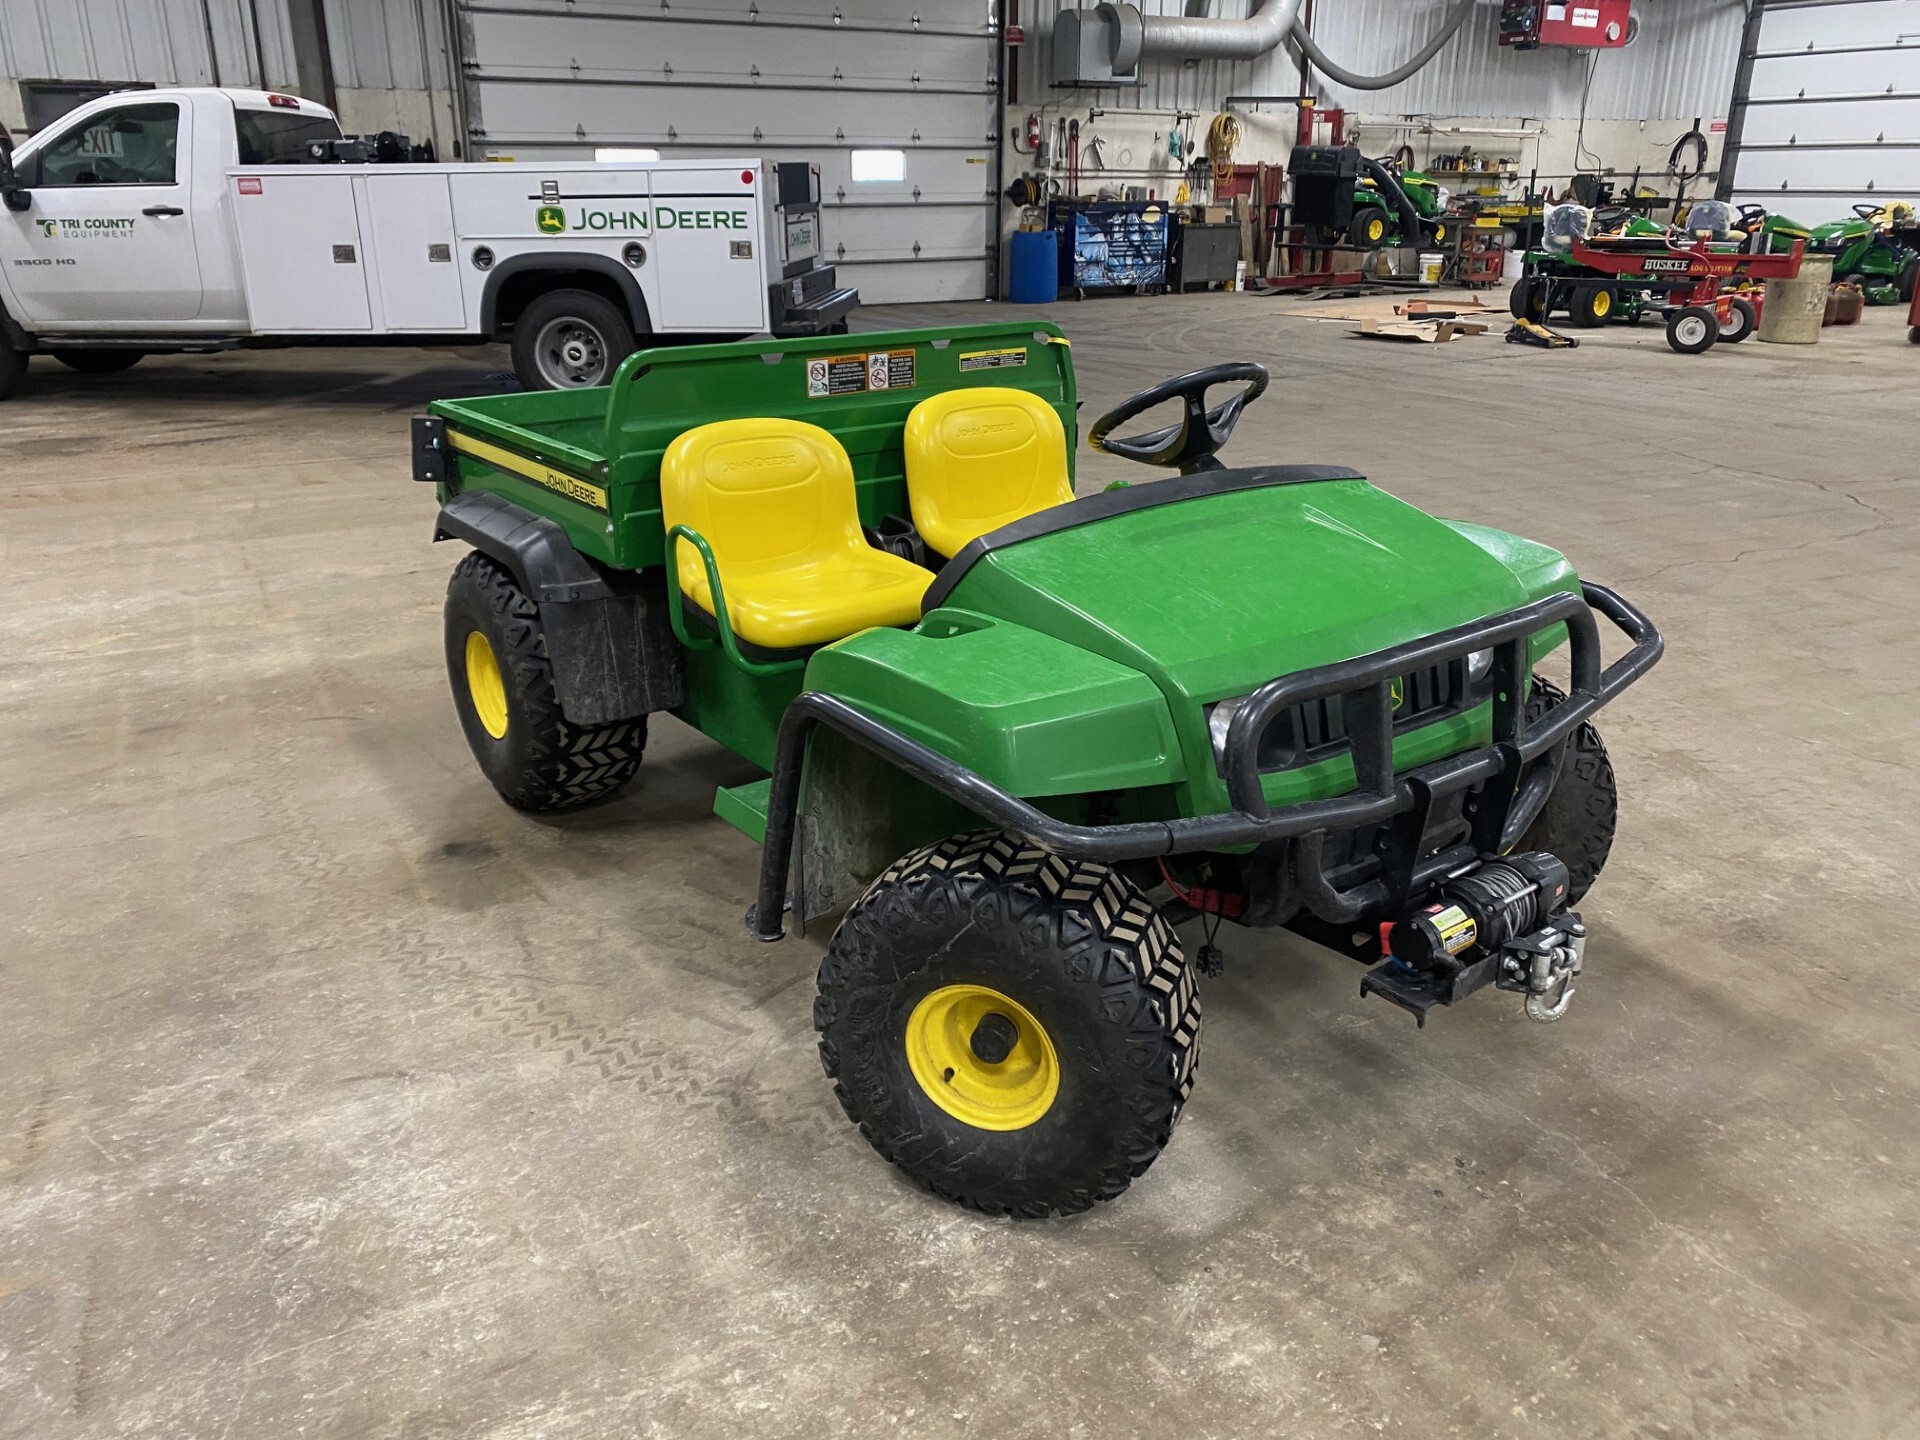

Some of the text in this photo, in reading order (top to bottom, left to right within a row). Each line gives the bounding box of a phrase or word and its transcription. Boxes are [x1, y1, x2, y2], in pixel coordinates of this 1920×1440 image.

[81, 129, 116, 154] EXIT
[59, 219, 135, 229] TRI COUNTY
[572, 207, 748, 230] JOHN DEERE
[63, 230, 134, 238] EQUIPMENT
[1644, 259, 1689, 271] HUSKEE
[544, 470, 597, 506] JOHN DEERE
